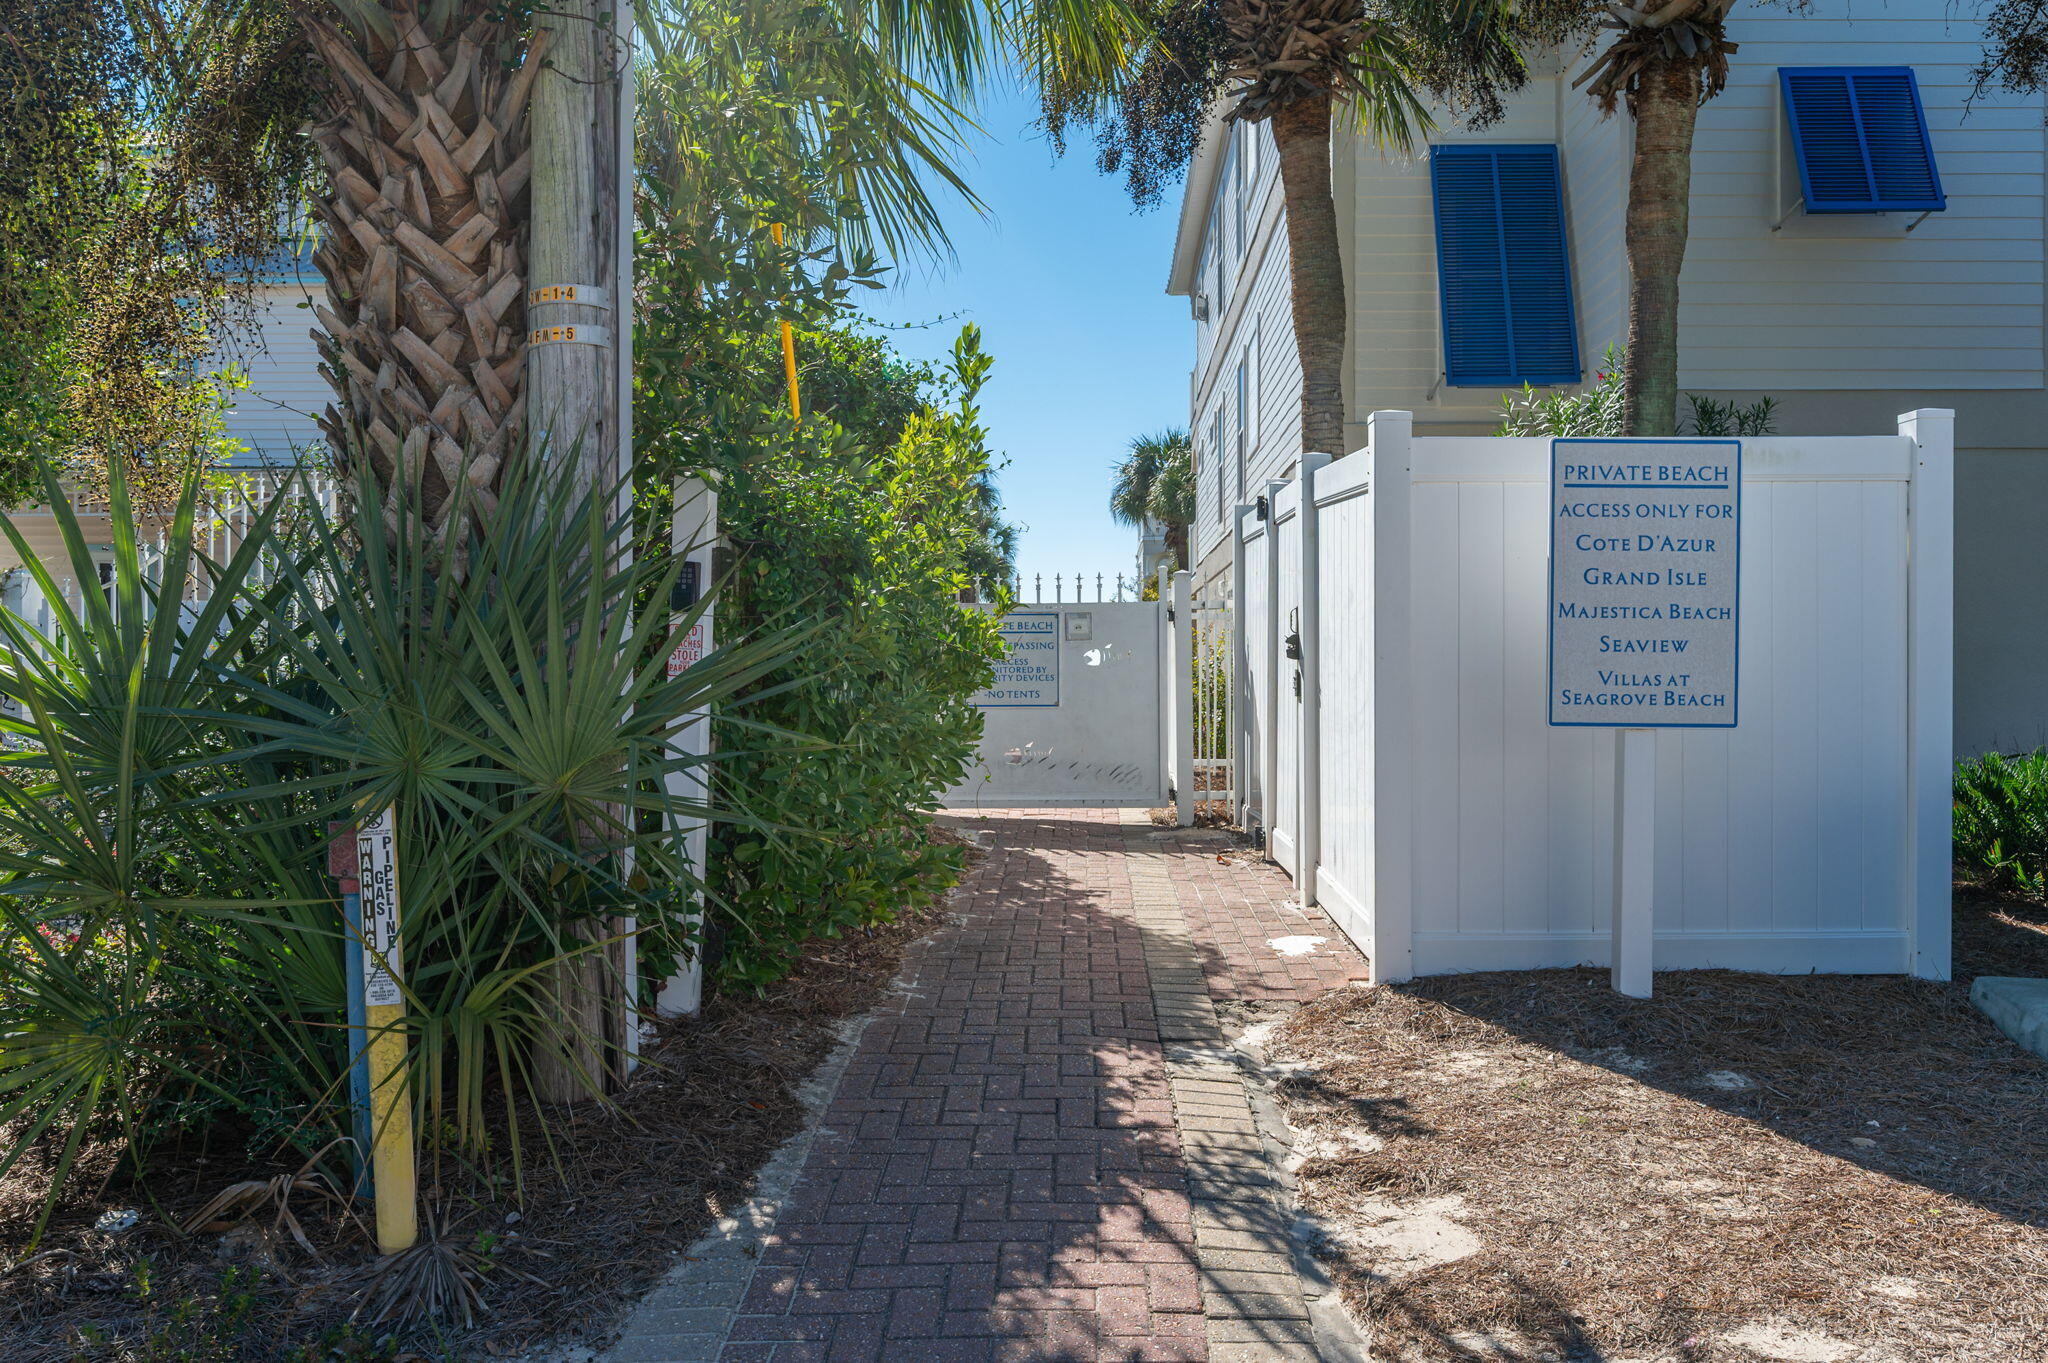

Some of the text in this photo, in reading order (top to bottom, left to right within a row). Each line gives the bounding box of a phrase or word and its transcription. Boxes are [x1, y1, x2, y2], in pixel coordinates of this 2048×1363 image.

[1564, 465, 1729, 481] PRIVATE BEACH
[1560, 503, 1733, 519] ACCESS ONLY FOR
[1576, 534, 1630, 551] COTE
[1583, 567, 1707, 586] GRAND ISLE
[1559, 602, 1731, 620] MAJESTICA BEACH
[1017, 621, 1053, 630] BEACH
[1600, 635, 1689, 653] SEAVIEW
[671, 650, 699, 660] STOLE
[992, 666, 1047, 674] NITORED BY
[992, 674, 1055, 682] RITY DEVICES
[1598, 670, 1690, 686] VILLAS AT
[1006, 690, 1040, 699] TENTS
[1561, 690, 1725, 707] SEAGROVE BEACH
[359, 839, 376, 949] WARNING
[374, 870, 386, 916] GAS
[382, 836, 396, 949] PIPELINE
